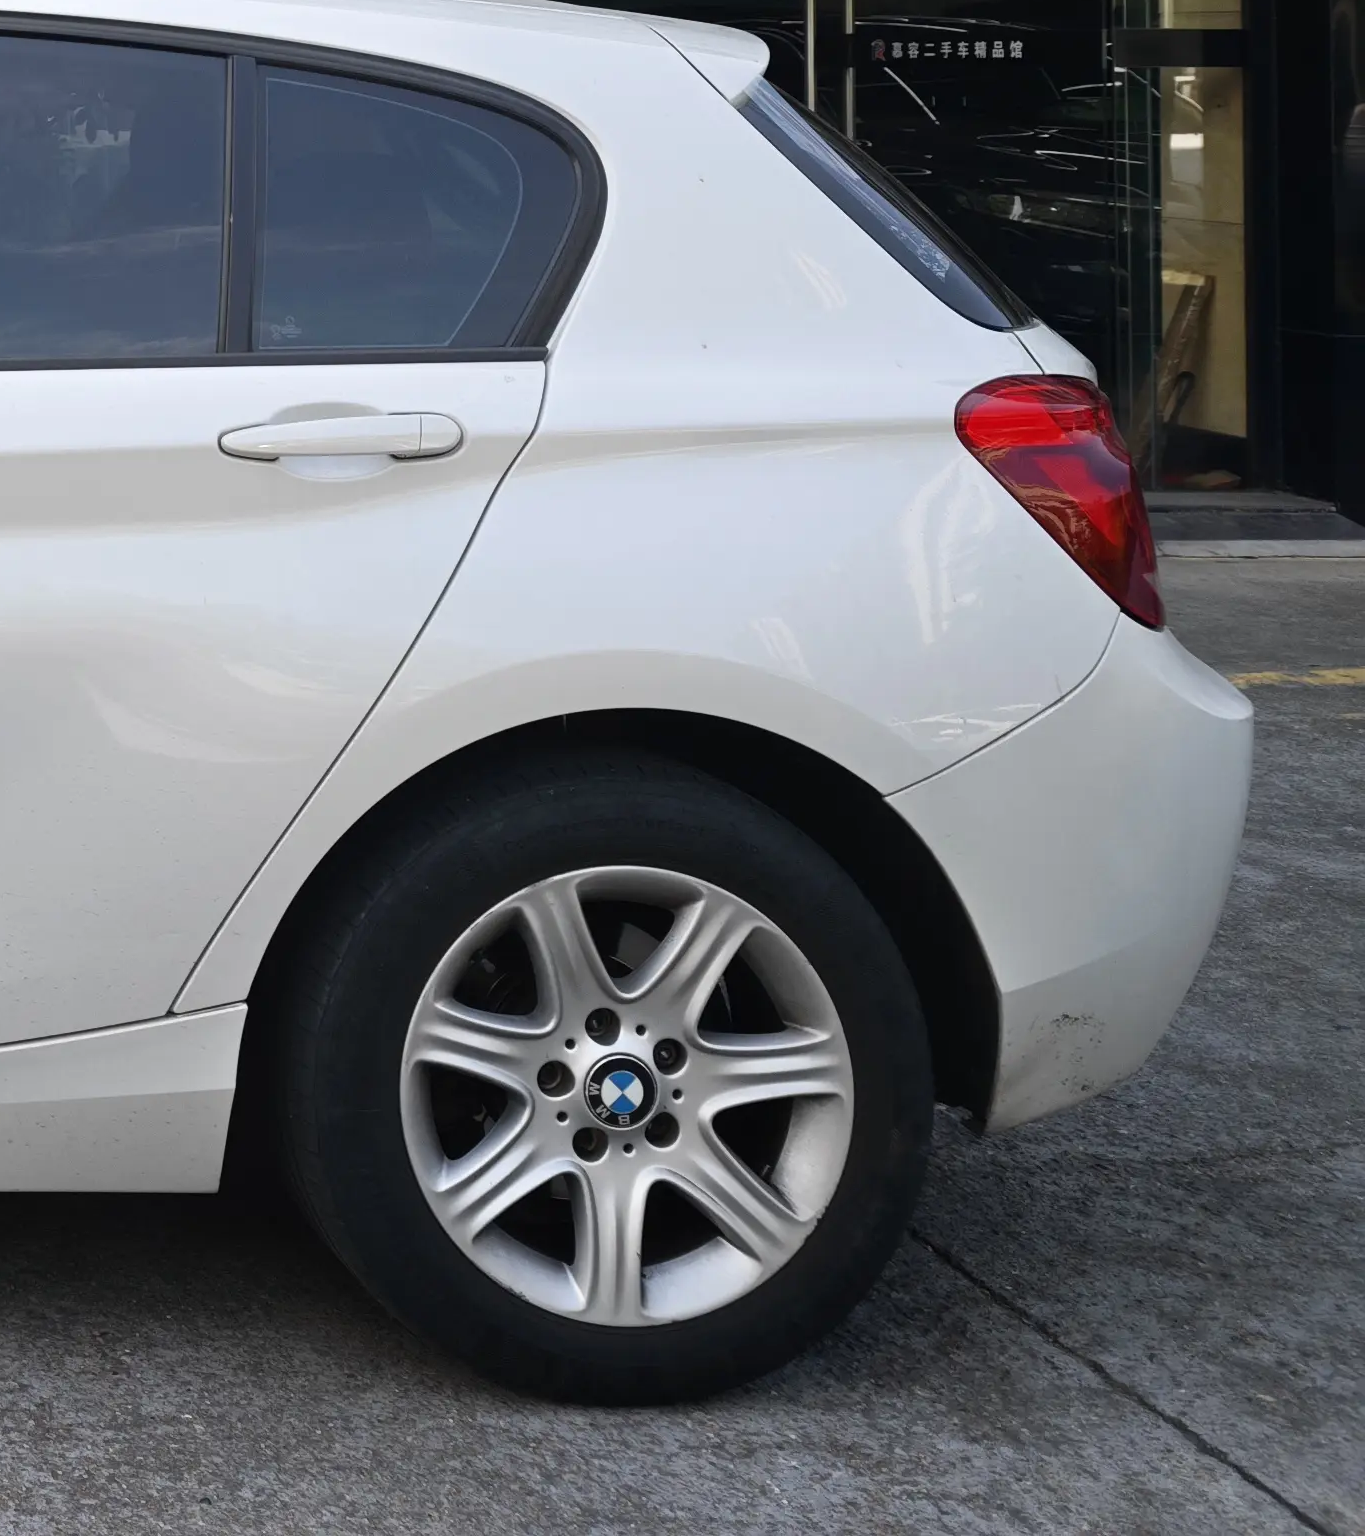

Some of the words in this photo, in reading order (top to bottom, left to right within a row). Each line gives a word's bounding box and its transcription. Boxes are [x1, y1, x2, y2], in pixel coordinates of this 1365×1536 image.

[891, 40, 1024, 59] 慕容二手车精品馆
